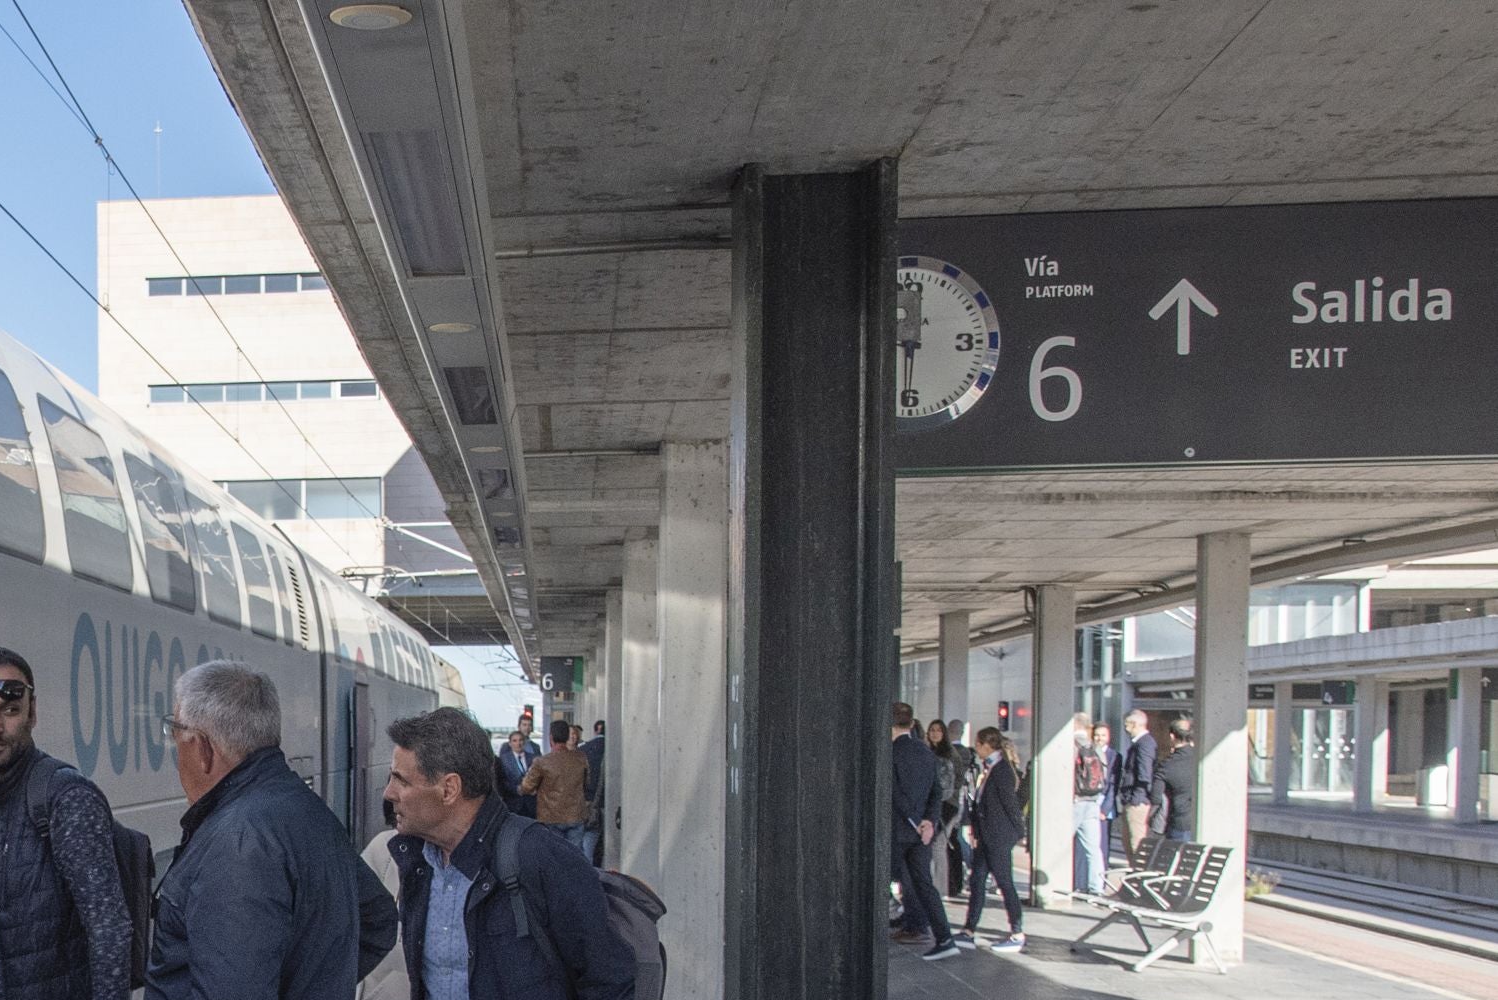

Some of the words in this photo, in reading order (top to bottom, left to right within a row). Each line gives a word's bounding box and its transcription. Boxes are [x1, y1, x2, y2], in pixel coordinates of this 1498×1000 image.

[1024, 254, 1059, 278] Vía
[1025, 284, 1094, 299] PLATFORM
[1291, 277, 1454, 325] Salida
[955, 333, 974, 352] 3
[1290, 346, 1349, 369] EXIT
[1027, 335, 1083, 422] 6
[900, 389, 919, 408] 6
[542, 672, 554, 691] 6
